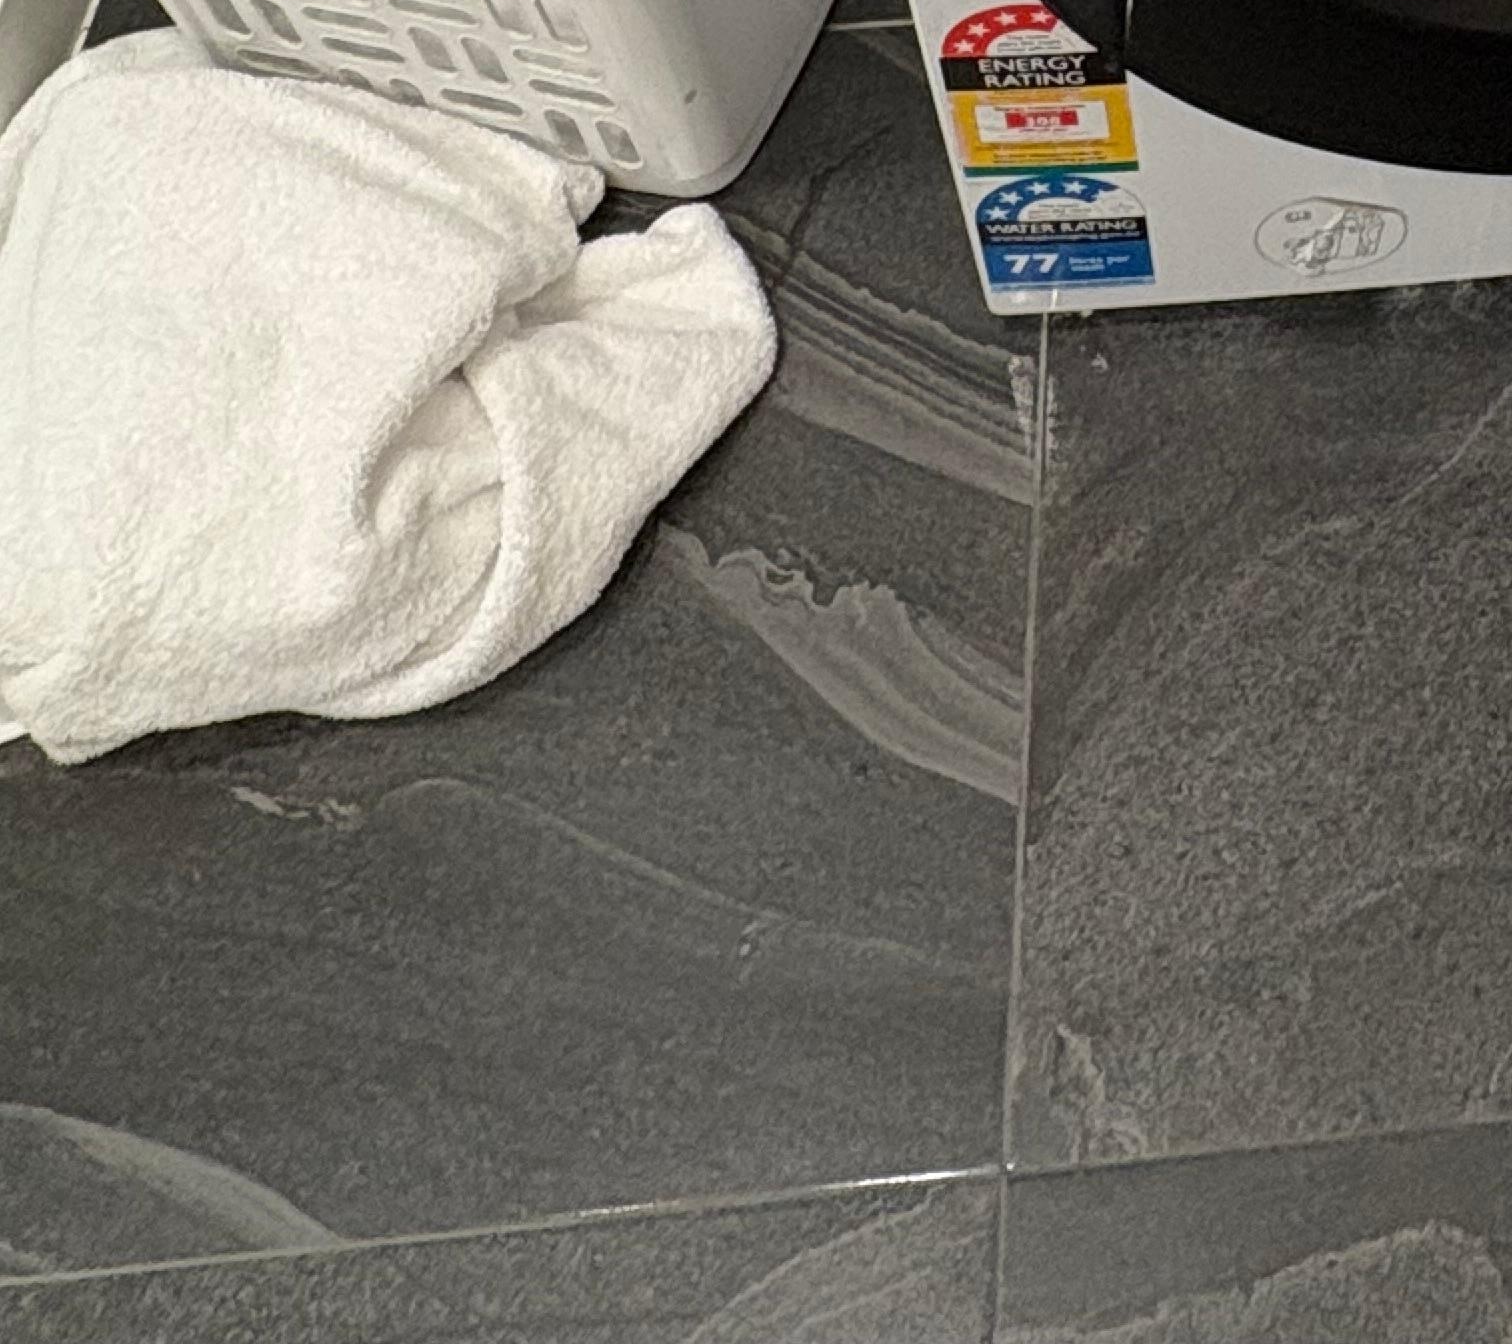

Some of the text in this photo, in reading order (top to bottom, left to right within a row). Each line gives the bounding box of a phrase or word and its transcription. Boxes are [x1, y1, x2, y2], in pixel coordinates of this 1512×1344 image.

[977, 55, 1086, 75] ENERGY
[984, 71, 1087, 88] RATING
[984, 217, 1138, 235] WATER RATING
[1003, 252, 1060, 274] 77
